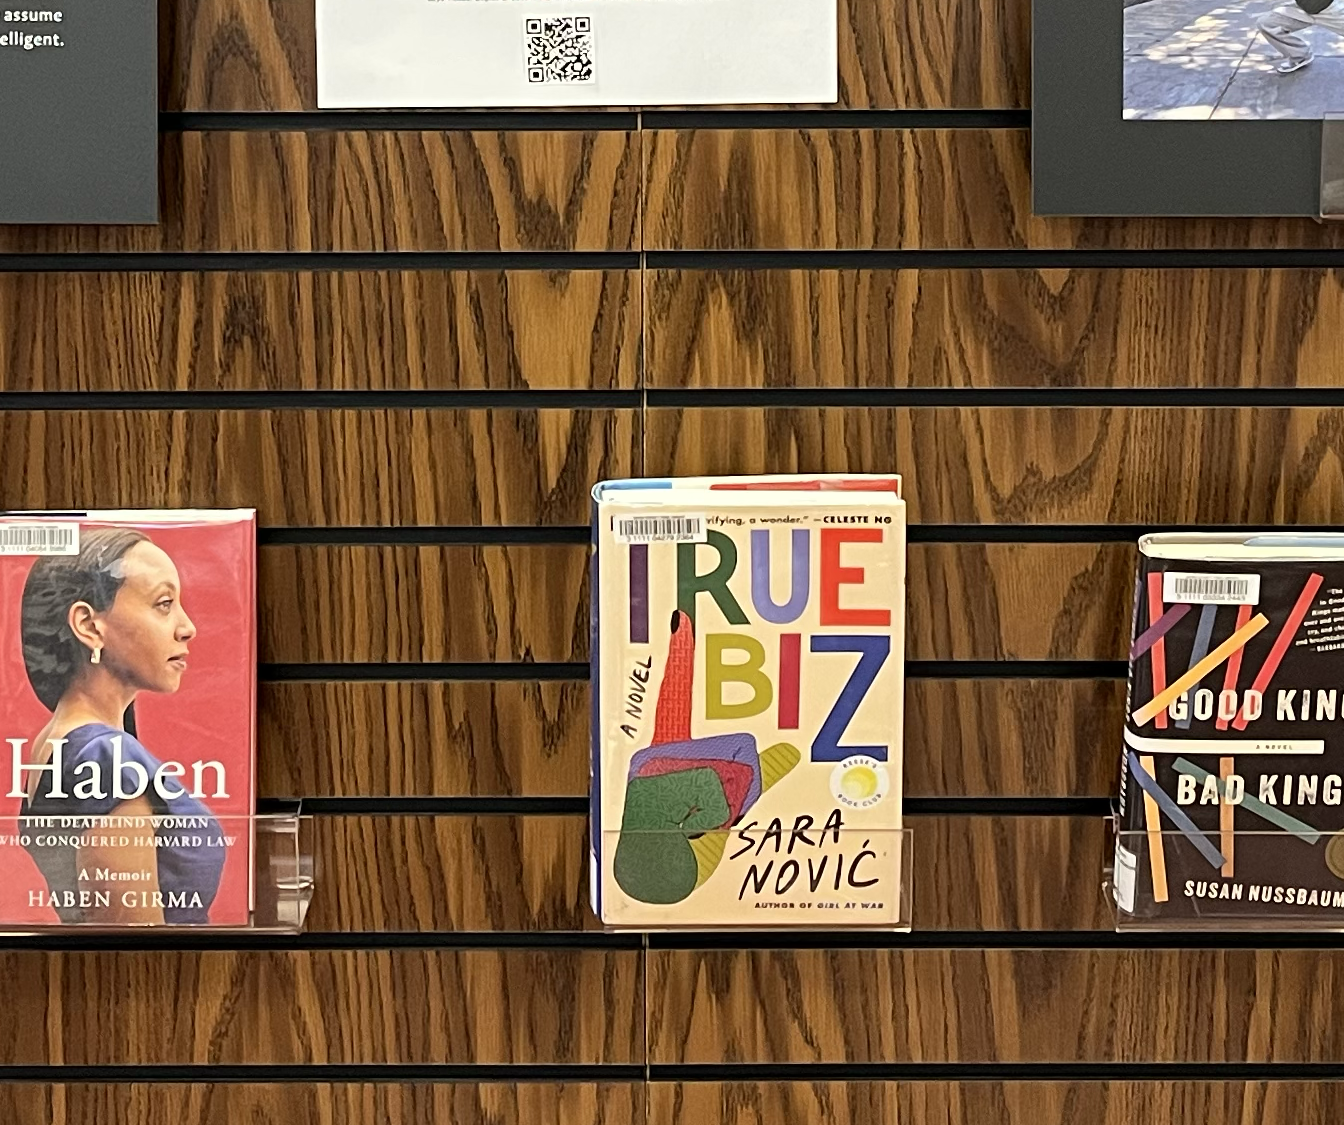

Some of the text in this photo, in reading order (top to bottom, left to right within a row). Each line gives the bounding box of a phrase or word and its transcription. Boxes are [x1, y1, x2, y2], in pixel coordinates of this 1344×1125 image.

[620, 655, 652, 740] A NOVEL
[705, 633, 891, 763] BIZ
[1169, 689, 1263, 721] GOOD
[5, 735, 230, 800] Haben
[1177, 774, 1245, 806] BAD
[23, 817, 209, 829] THE DEAFBLIND WOMAN
[730, 809, 844, 860] SARA
[36, 835, 130, 849] CONQUERED
[134, 835, 202, 847] HARVARD
[206, 836, 237, 847] LAW
[78, 868, 151, 881] A Memoir
[739, 839, 879, 901] NOVIĆ
[28, 890, 203, 909] HABEN GIRMA
[1184, 880, 1243, 900] SUSAN
